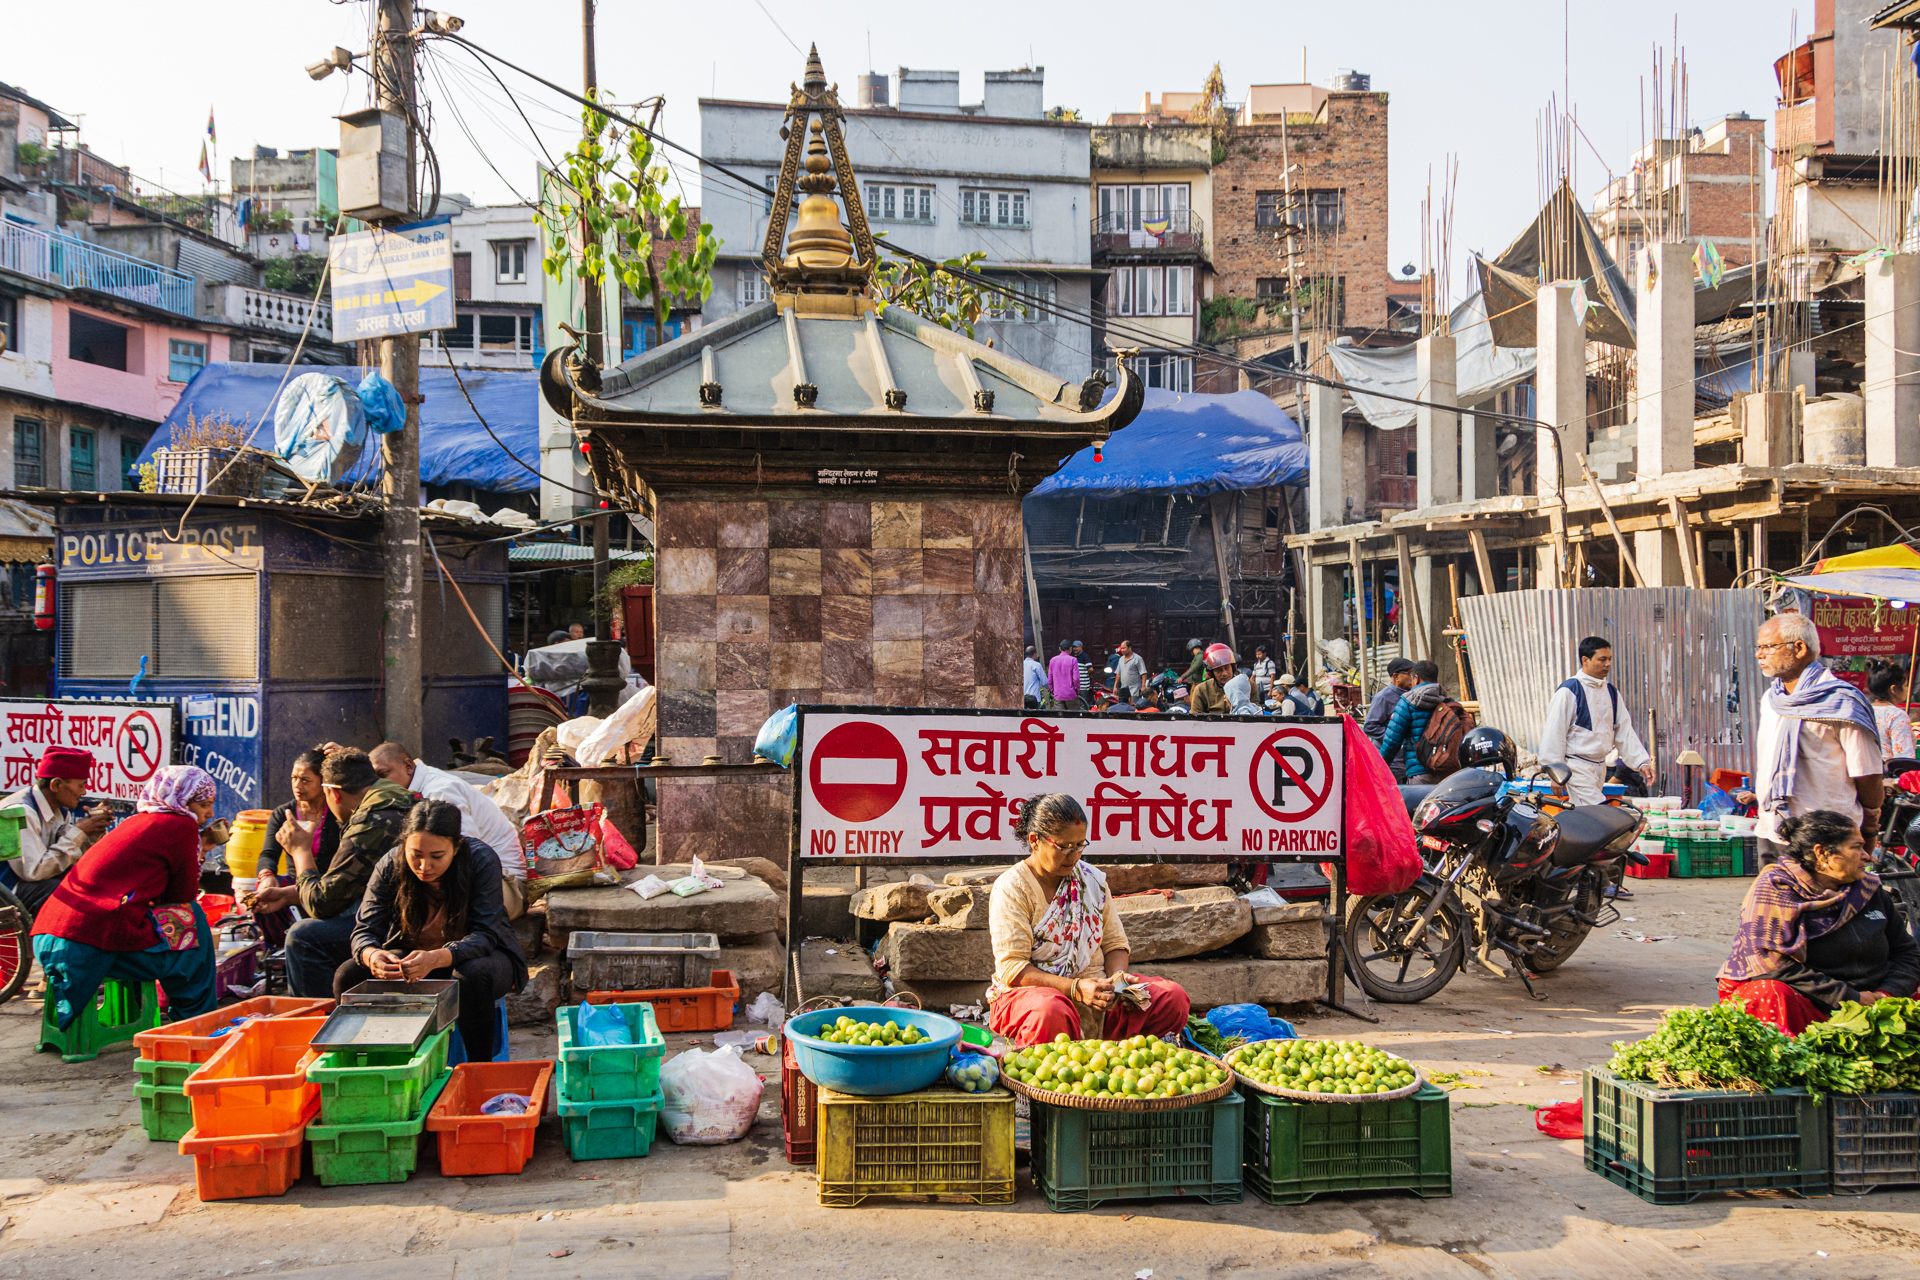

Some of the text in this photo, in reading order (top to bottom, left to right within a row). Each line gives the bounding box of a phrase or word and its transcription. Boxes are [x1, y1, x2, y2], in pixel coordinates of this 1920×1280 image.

[411, 249, 430, 260] BANK
[356, 314, 389, 333] असन
[393, 310, 426, 328] शाखा
[63, 525, 257, 566] POLICE POST
[6, 703, 116, 748] सवारी साधन
[918, 717, 1236, 779] सवारी साधन
[4, 747, 41, 790] प्रवे
[205, 750, 257, 801] CIRCLE
[115, 782, 126, 798] NO
[1086, 781, 1233, 842] निषेध
[810, 829, 904, 855] NO ENTRY
[1241, 828, 1338, 852] NO PARKING
[606, 955, 668, 966] TODAY MILK
